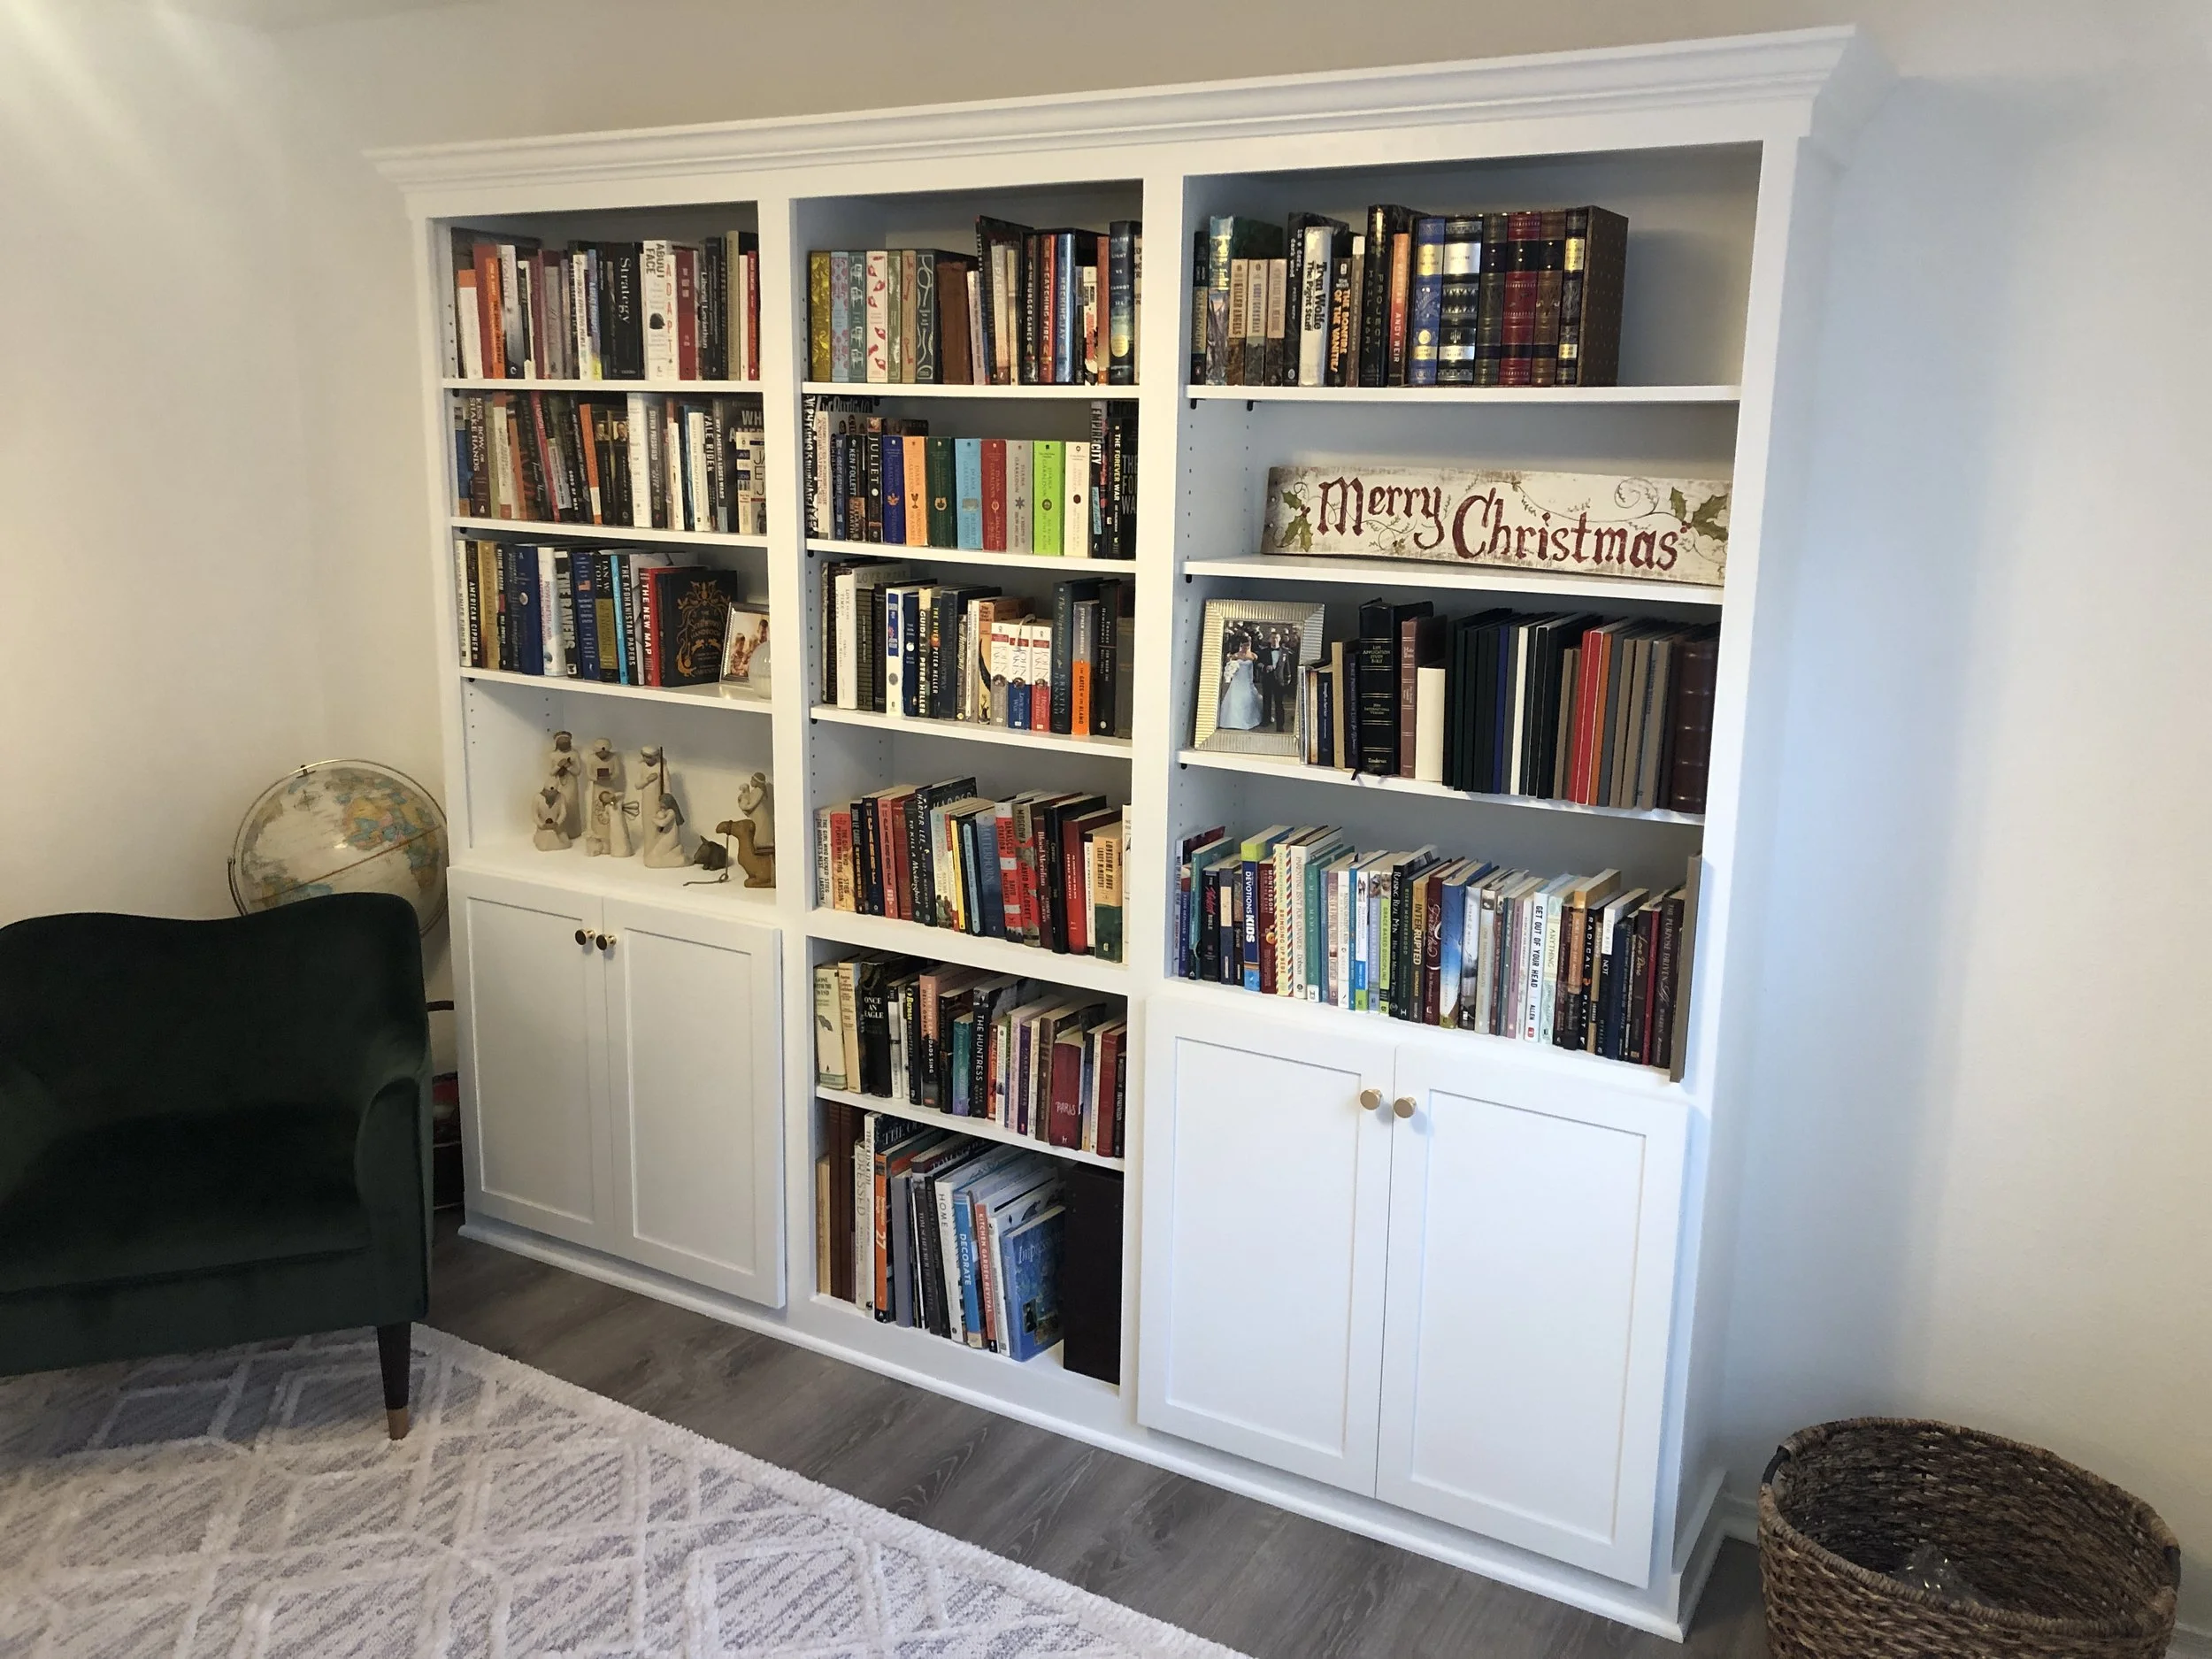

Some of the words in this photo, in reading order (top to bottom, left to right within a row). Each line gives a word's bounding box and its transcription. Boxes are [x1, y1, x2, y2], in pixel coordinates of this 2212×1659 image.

[646, 248, 655, 274] FACE
[657, 243, 665, 278] ABOUT
[618, 257, 631, 324] Strategy
[1317, 262, 1327, 291] Tom
[1365, 270, 1375, 307] HAIL
[1234, 283, 1243, 308] KILLER
[1304, 281, 1313, 306] Right
[1333, 289, 1341, 303] OF
[1342, 289, 1351, 309] THE
[1233, 310, 1241, 334] ANGELS
[1304, 309, 1313, 331] Stuff
[1314, 294, 1325, 330] Wolfe
[1333, 307, 1341, 325] THE
[1374, 273, 1384, 348] PROJECT
[1340, 311, 1350, 354] BONFIRE
[1331, 326, 1340, 373] VANITIES
[704, 416, 714, 438] PALE
[1091, 408, 1102, 443] EMPIRE
[870, 436, 879, 484] JULIET
[1091, 443, 1102, 465] CITY
[1317, 476, 1446, 550] Merry
[1451, 488, 1681, 571] Christmas
[557, 572, 571, 595] THE
[623, 582, 634, 634] AFGHANISTAN
[558, 598, 575, 649] RAVENS
[957, 635, 966, 671] Hemingway
[1033, 651, 1043, 677] JAKES
[910, 820, 914, 829] TO
[1004, 821, 1015, 855] DAMASCUS
[1016, 810, 1025, 838] MOSCOW
[1037, 832, 1046, 853] Blood
[911, 861, 920, 904] Mockingbird
[1020, 863, 1029, 882] DAVID
[1393, 872, 1402, 897] RAISING
[1392, 899, 1401, 916] REAL
[1535, 905, 1544, 918] GET
[1246, 914, 1255, 942] KIDS
[1392, 918, 1401, 933] MEN
[1413, 903, 1422, 965] INTERRUPTED
[1534, 922, 1543, 934] OUT
[1663, 918, 1673, 952] PURPOSE
[1280, 946, 1286, 955] UP
[1533, 937, 1542, 947] OF
[1548, 928, 1556, 968] ANYTHING
[1584, 917, 1594, 970] RADICAL
[1636, 935, 1648, 955] Love
[1532, 949, 1541, 967] YOUR
[1661, 953, 1671, 981] DRIVEN
[1530, 970, 1540, 988] HEAD
[975, 1034, 984, 1081] HUNTRESS
[856, 1153, 865, 1217] DRESSED
[938, 1194, 949, 1228] HOME
[876, 1230, 886, 1249] 27
[979, 1213, 987, 1247] KITCHEN
[959, 1233, 972, 1286] DECORATE
[980, 1248, 990, 1280] GARDEN
[985, 1282, 994, 1313] REVIVAL
